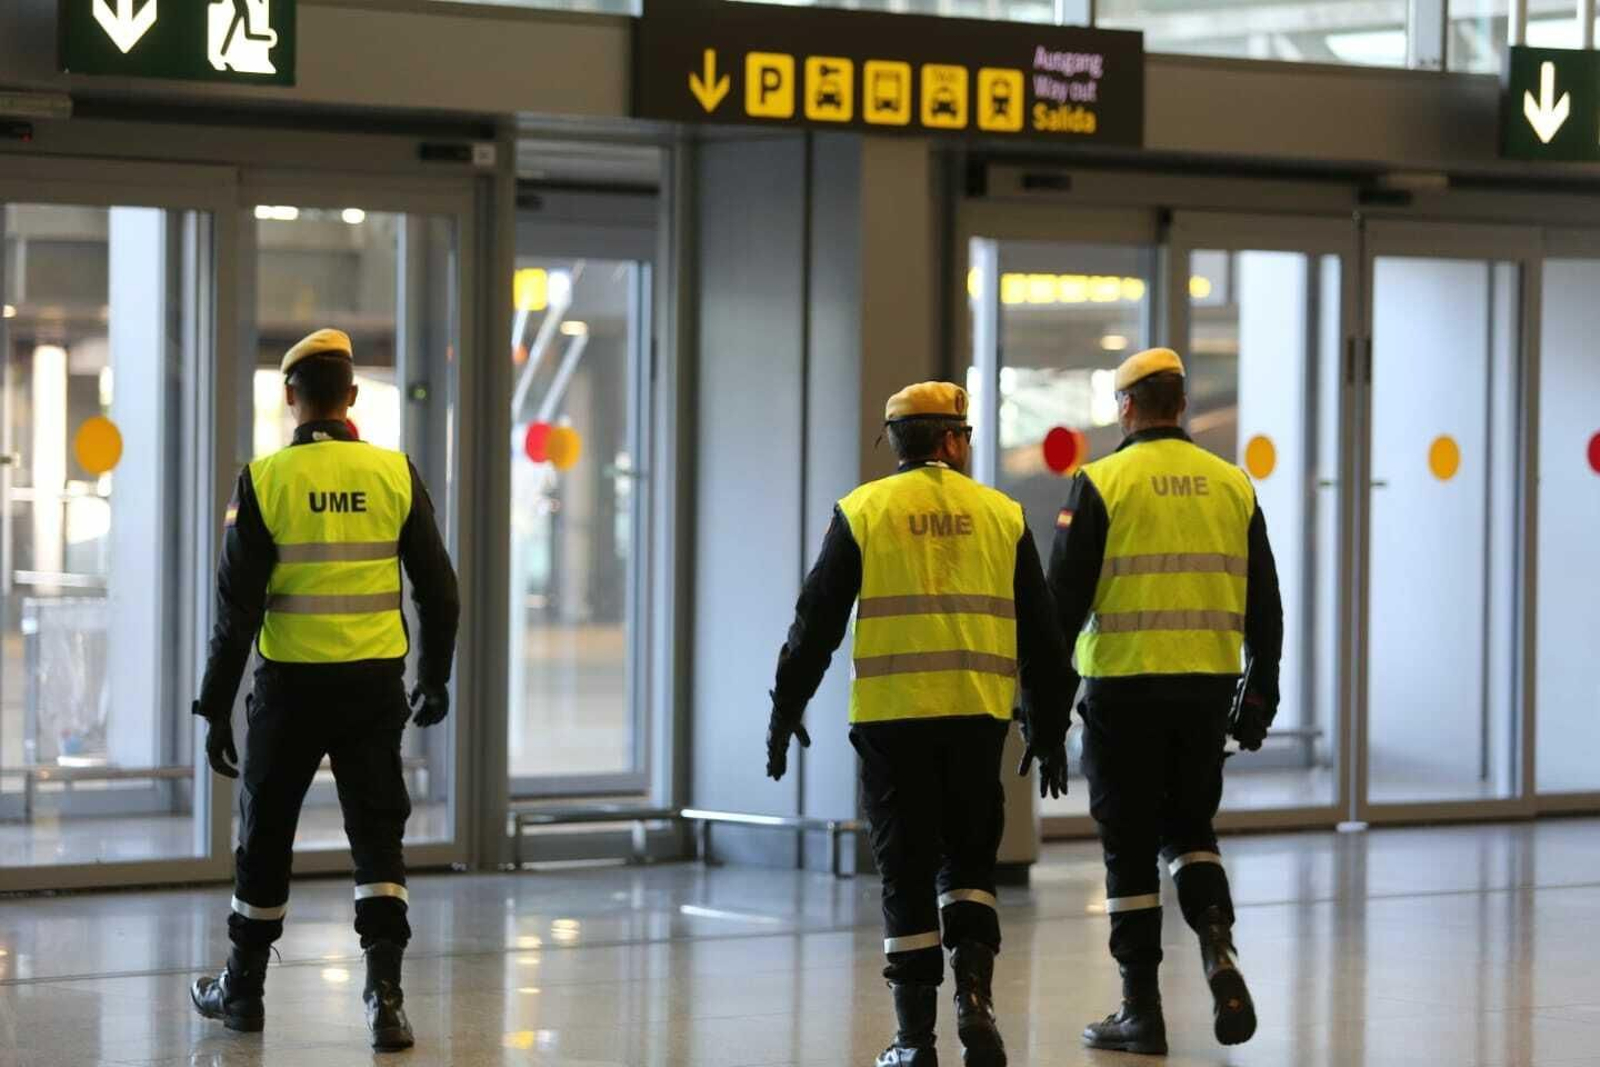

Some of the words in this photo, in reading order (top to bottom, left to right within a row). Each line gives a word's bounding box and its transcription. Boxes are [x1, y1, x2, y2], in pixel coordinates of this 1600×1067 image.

[1033, 46, 1103, 79] Ausgang
[761, 67, 782, 104] P
[1033, 74, 1068, 104] Way
[1069, 81, 1097, 102] out
[1033, 103, 1097, 133] Salida
[1151, 475, 1209, 497] UME
[308, 491, 367, 513] UME
[908, 513, 973, 537] UME
